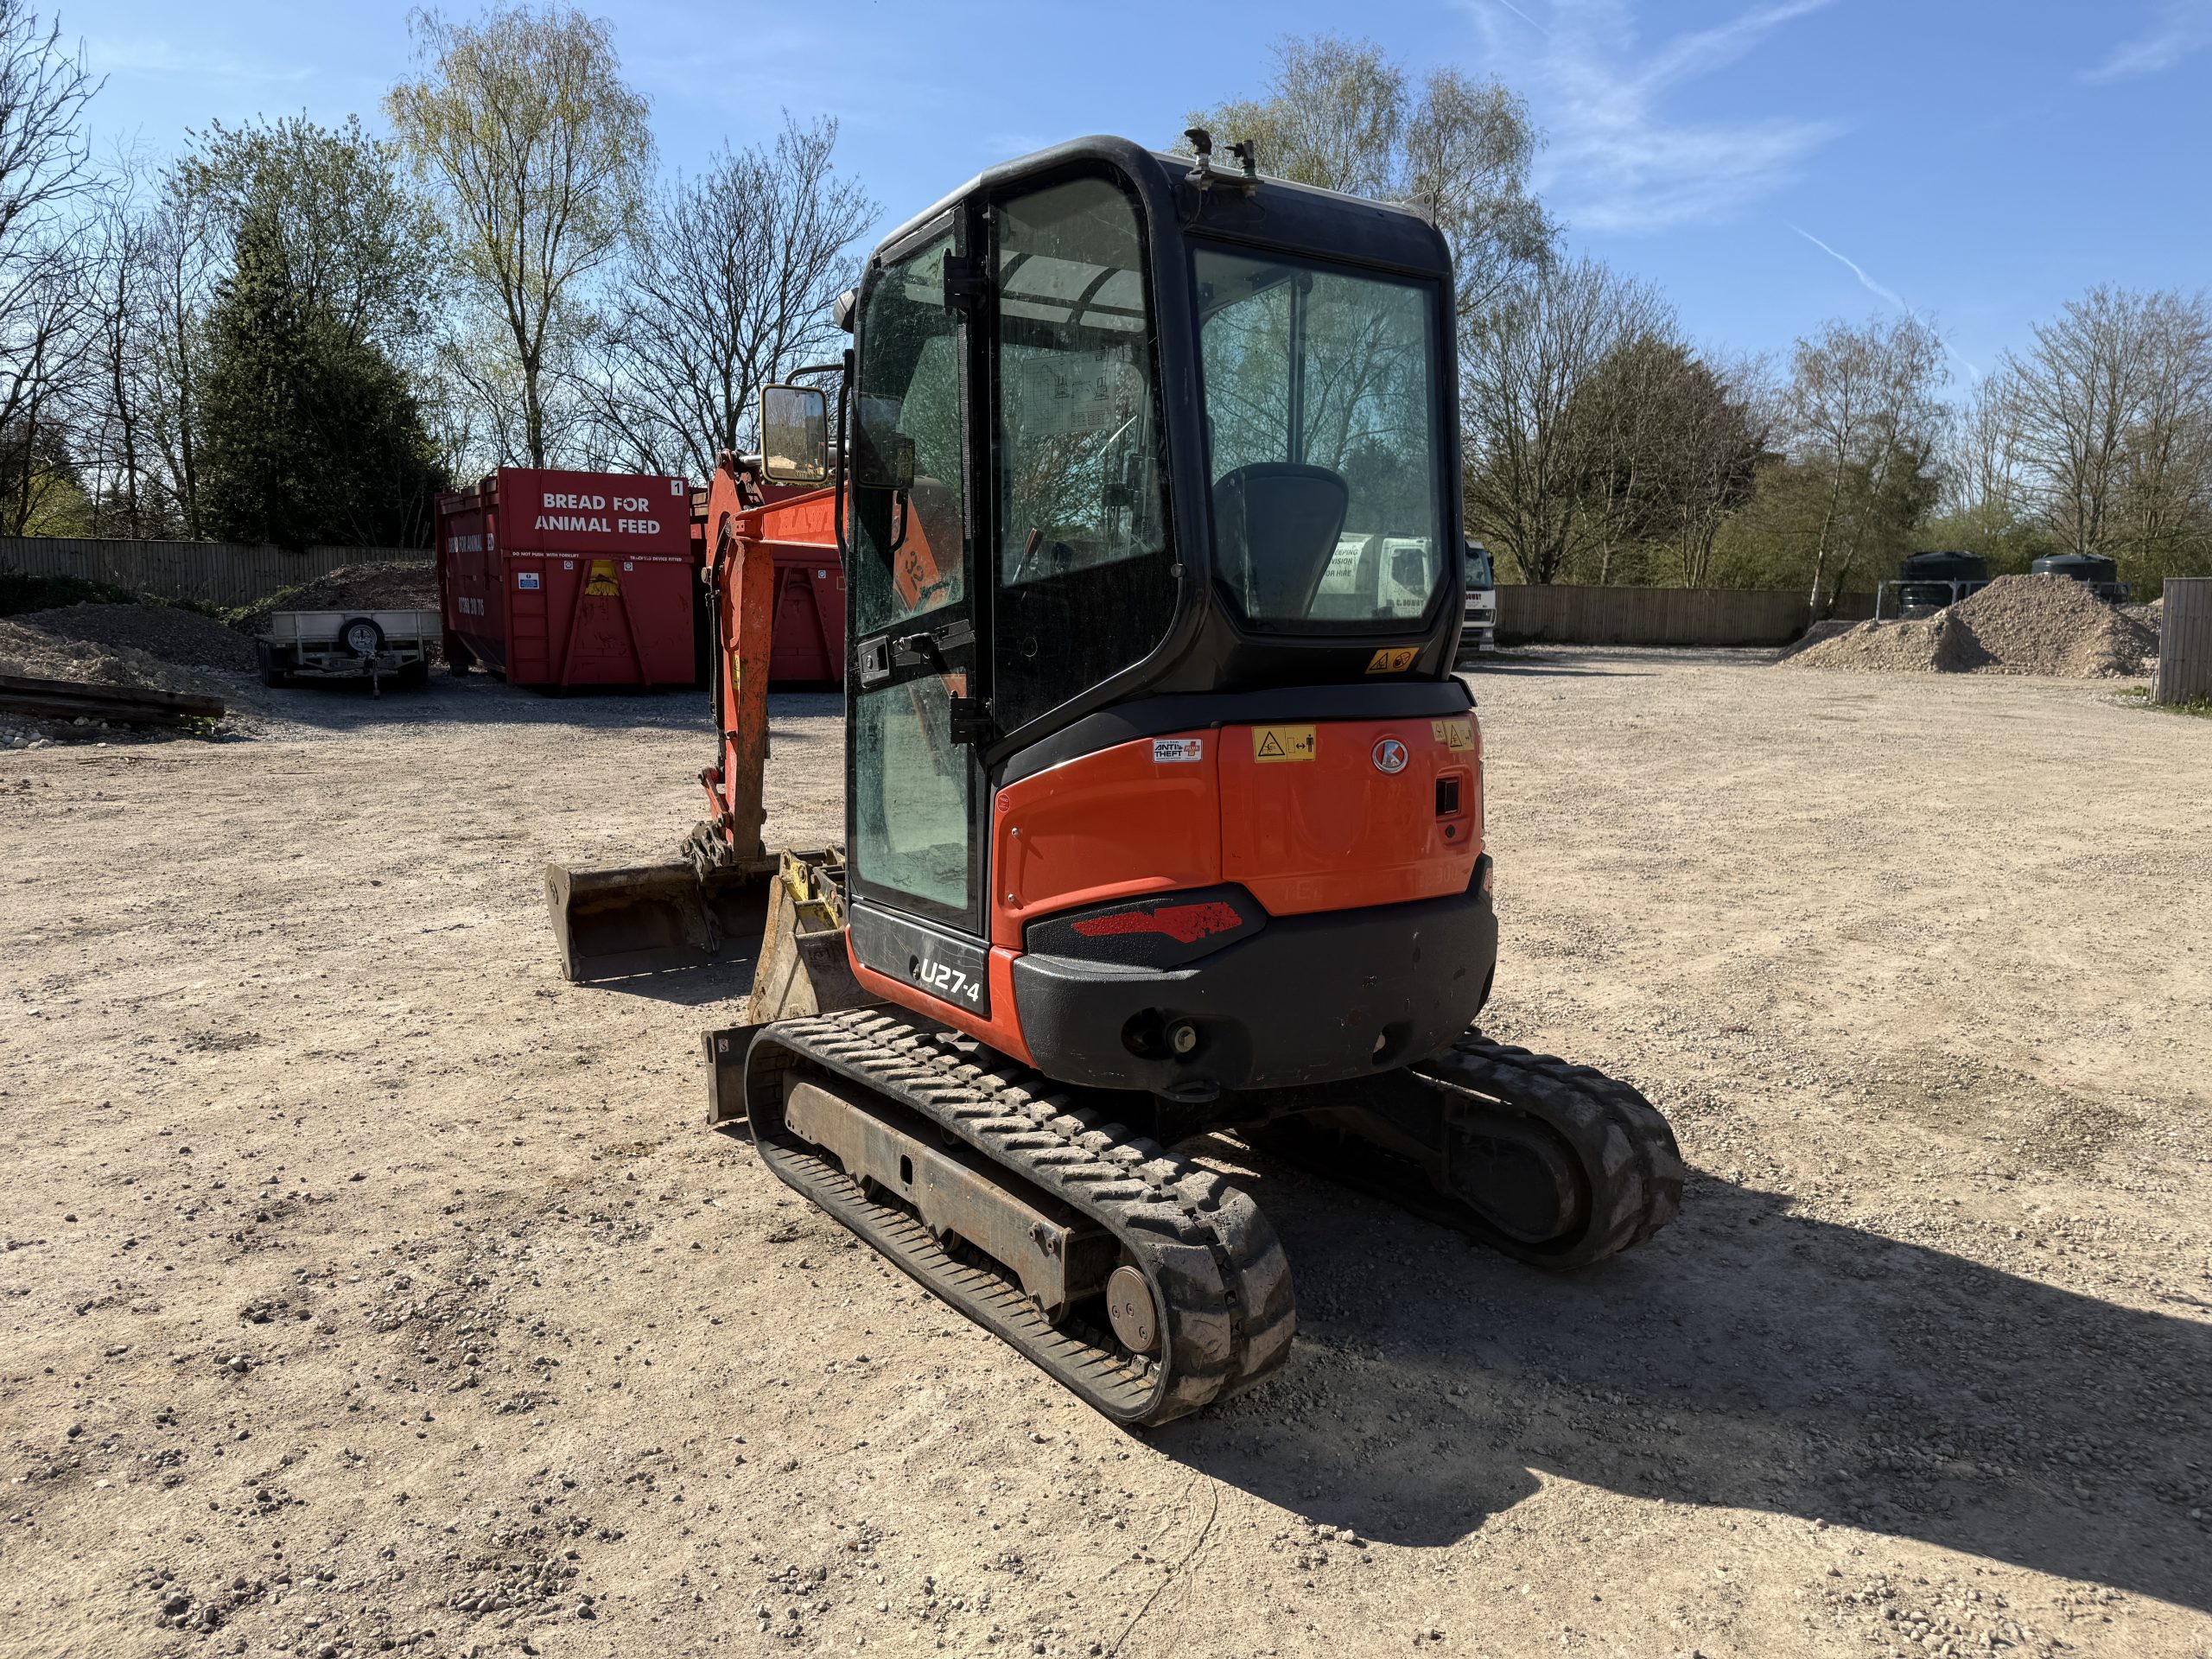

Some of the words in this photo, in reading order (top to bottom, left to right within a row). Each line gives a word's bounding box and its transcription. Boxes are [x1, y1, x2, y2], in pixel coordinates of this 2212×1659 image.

[674, 482, 680, 494] 1
[543, 493, 606, 510] BREAD
[613, 497, 650, 512] FOR
[535, 515, 611, 532] ANIMAL
[618, 518, 660, 535] FEED
